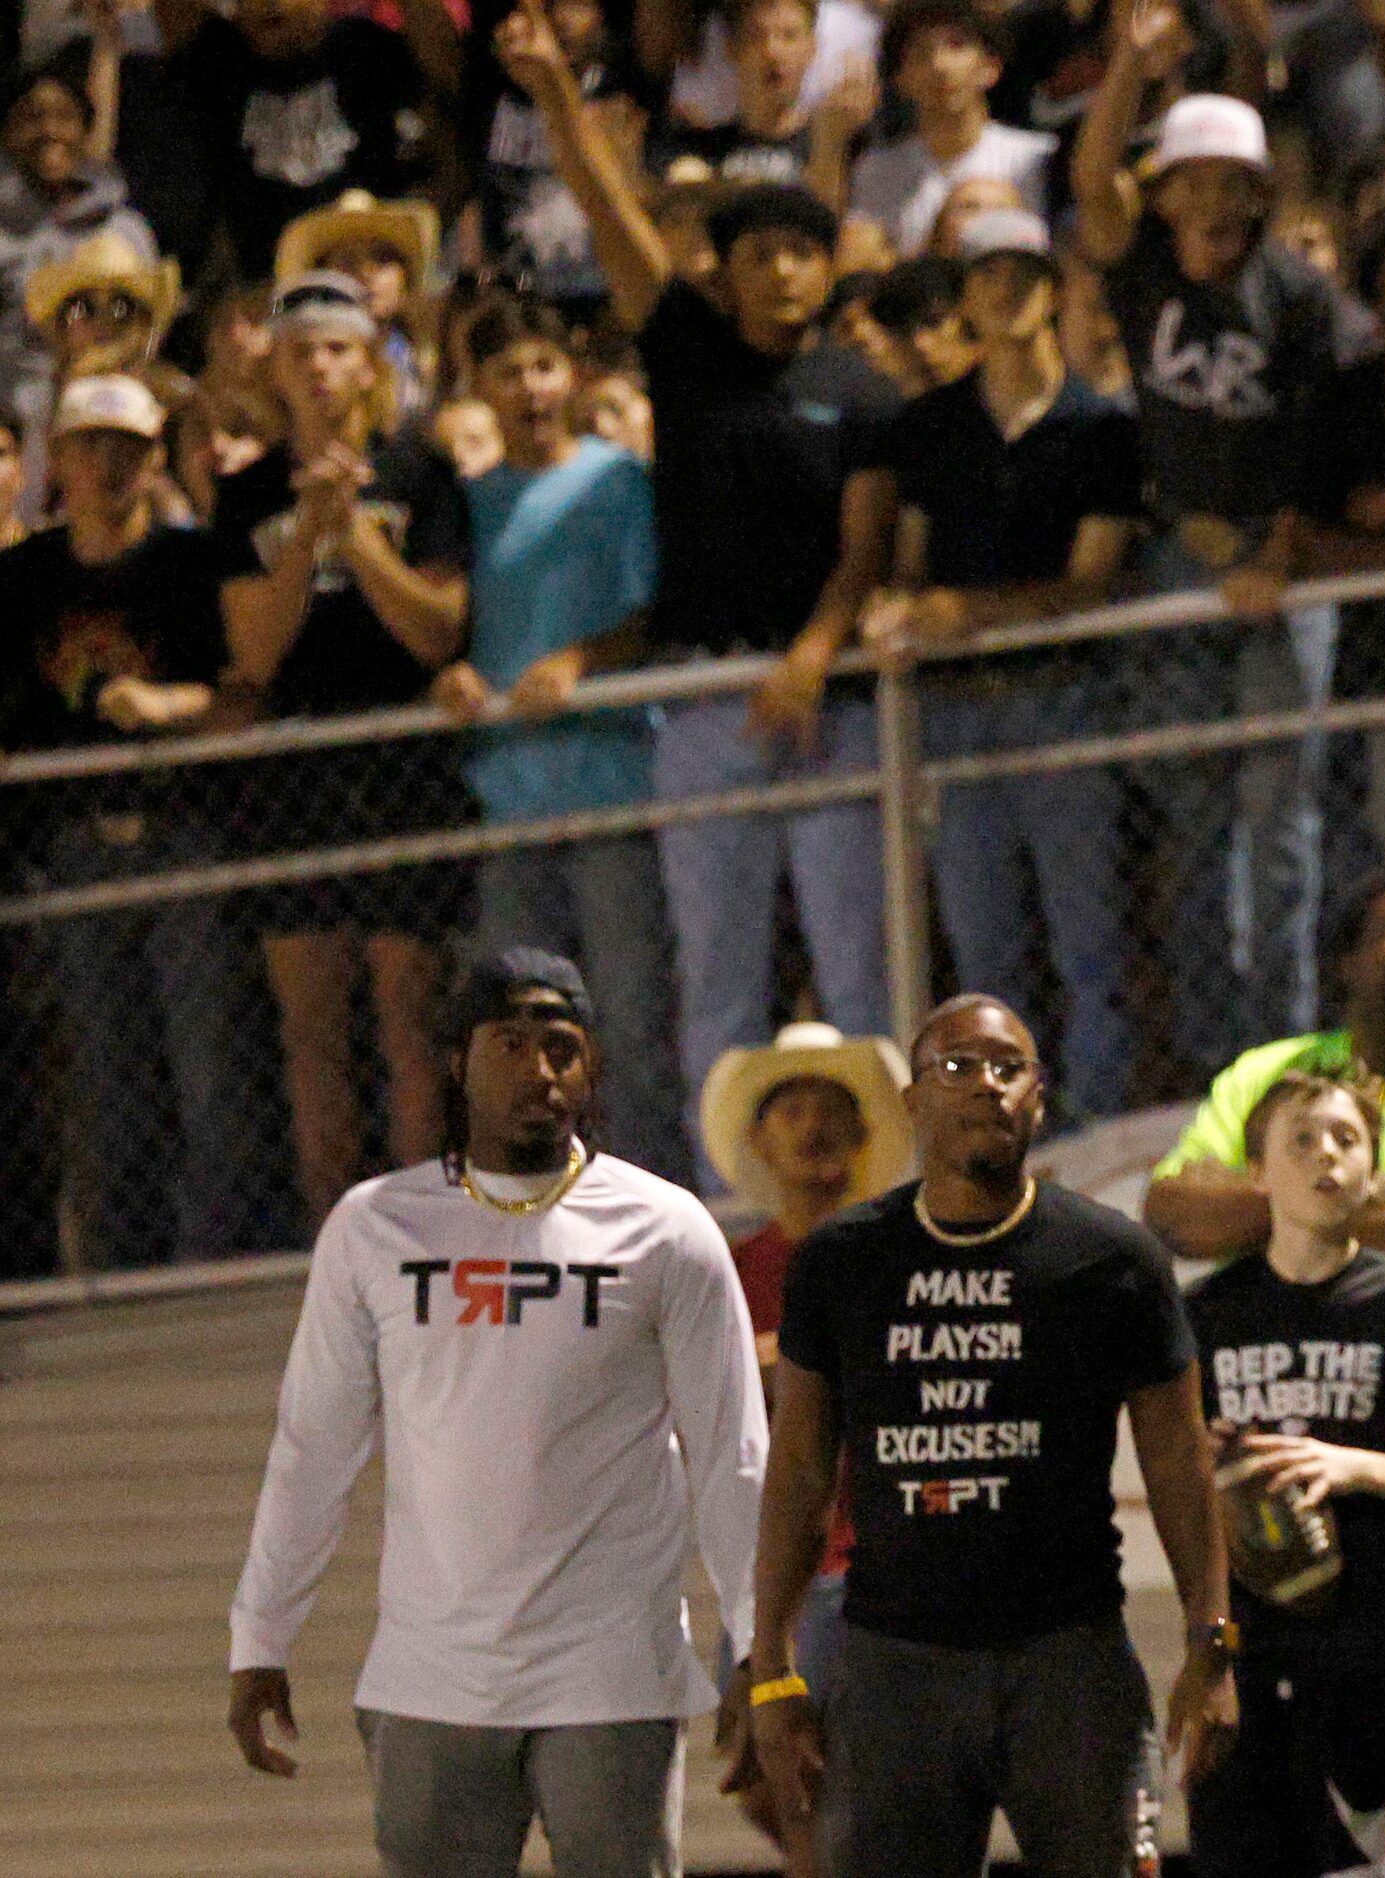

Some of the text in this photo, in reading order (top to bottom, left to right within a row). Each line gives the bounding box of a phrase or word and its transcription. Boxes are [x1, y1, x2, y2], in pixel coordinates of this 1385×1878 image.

[905, 1269, 1016, 1307] MAKE
[886, 1321, 1023, 1362] PLAYS!!
[1213, 1338, 1383, 1388] REP THE
[920, 1378, 993, 1415] NOT
[1217, 1376, 1378, 1424] RABBITS
[875, 1420, 1042, 1465] EXCUSES!!
